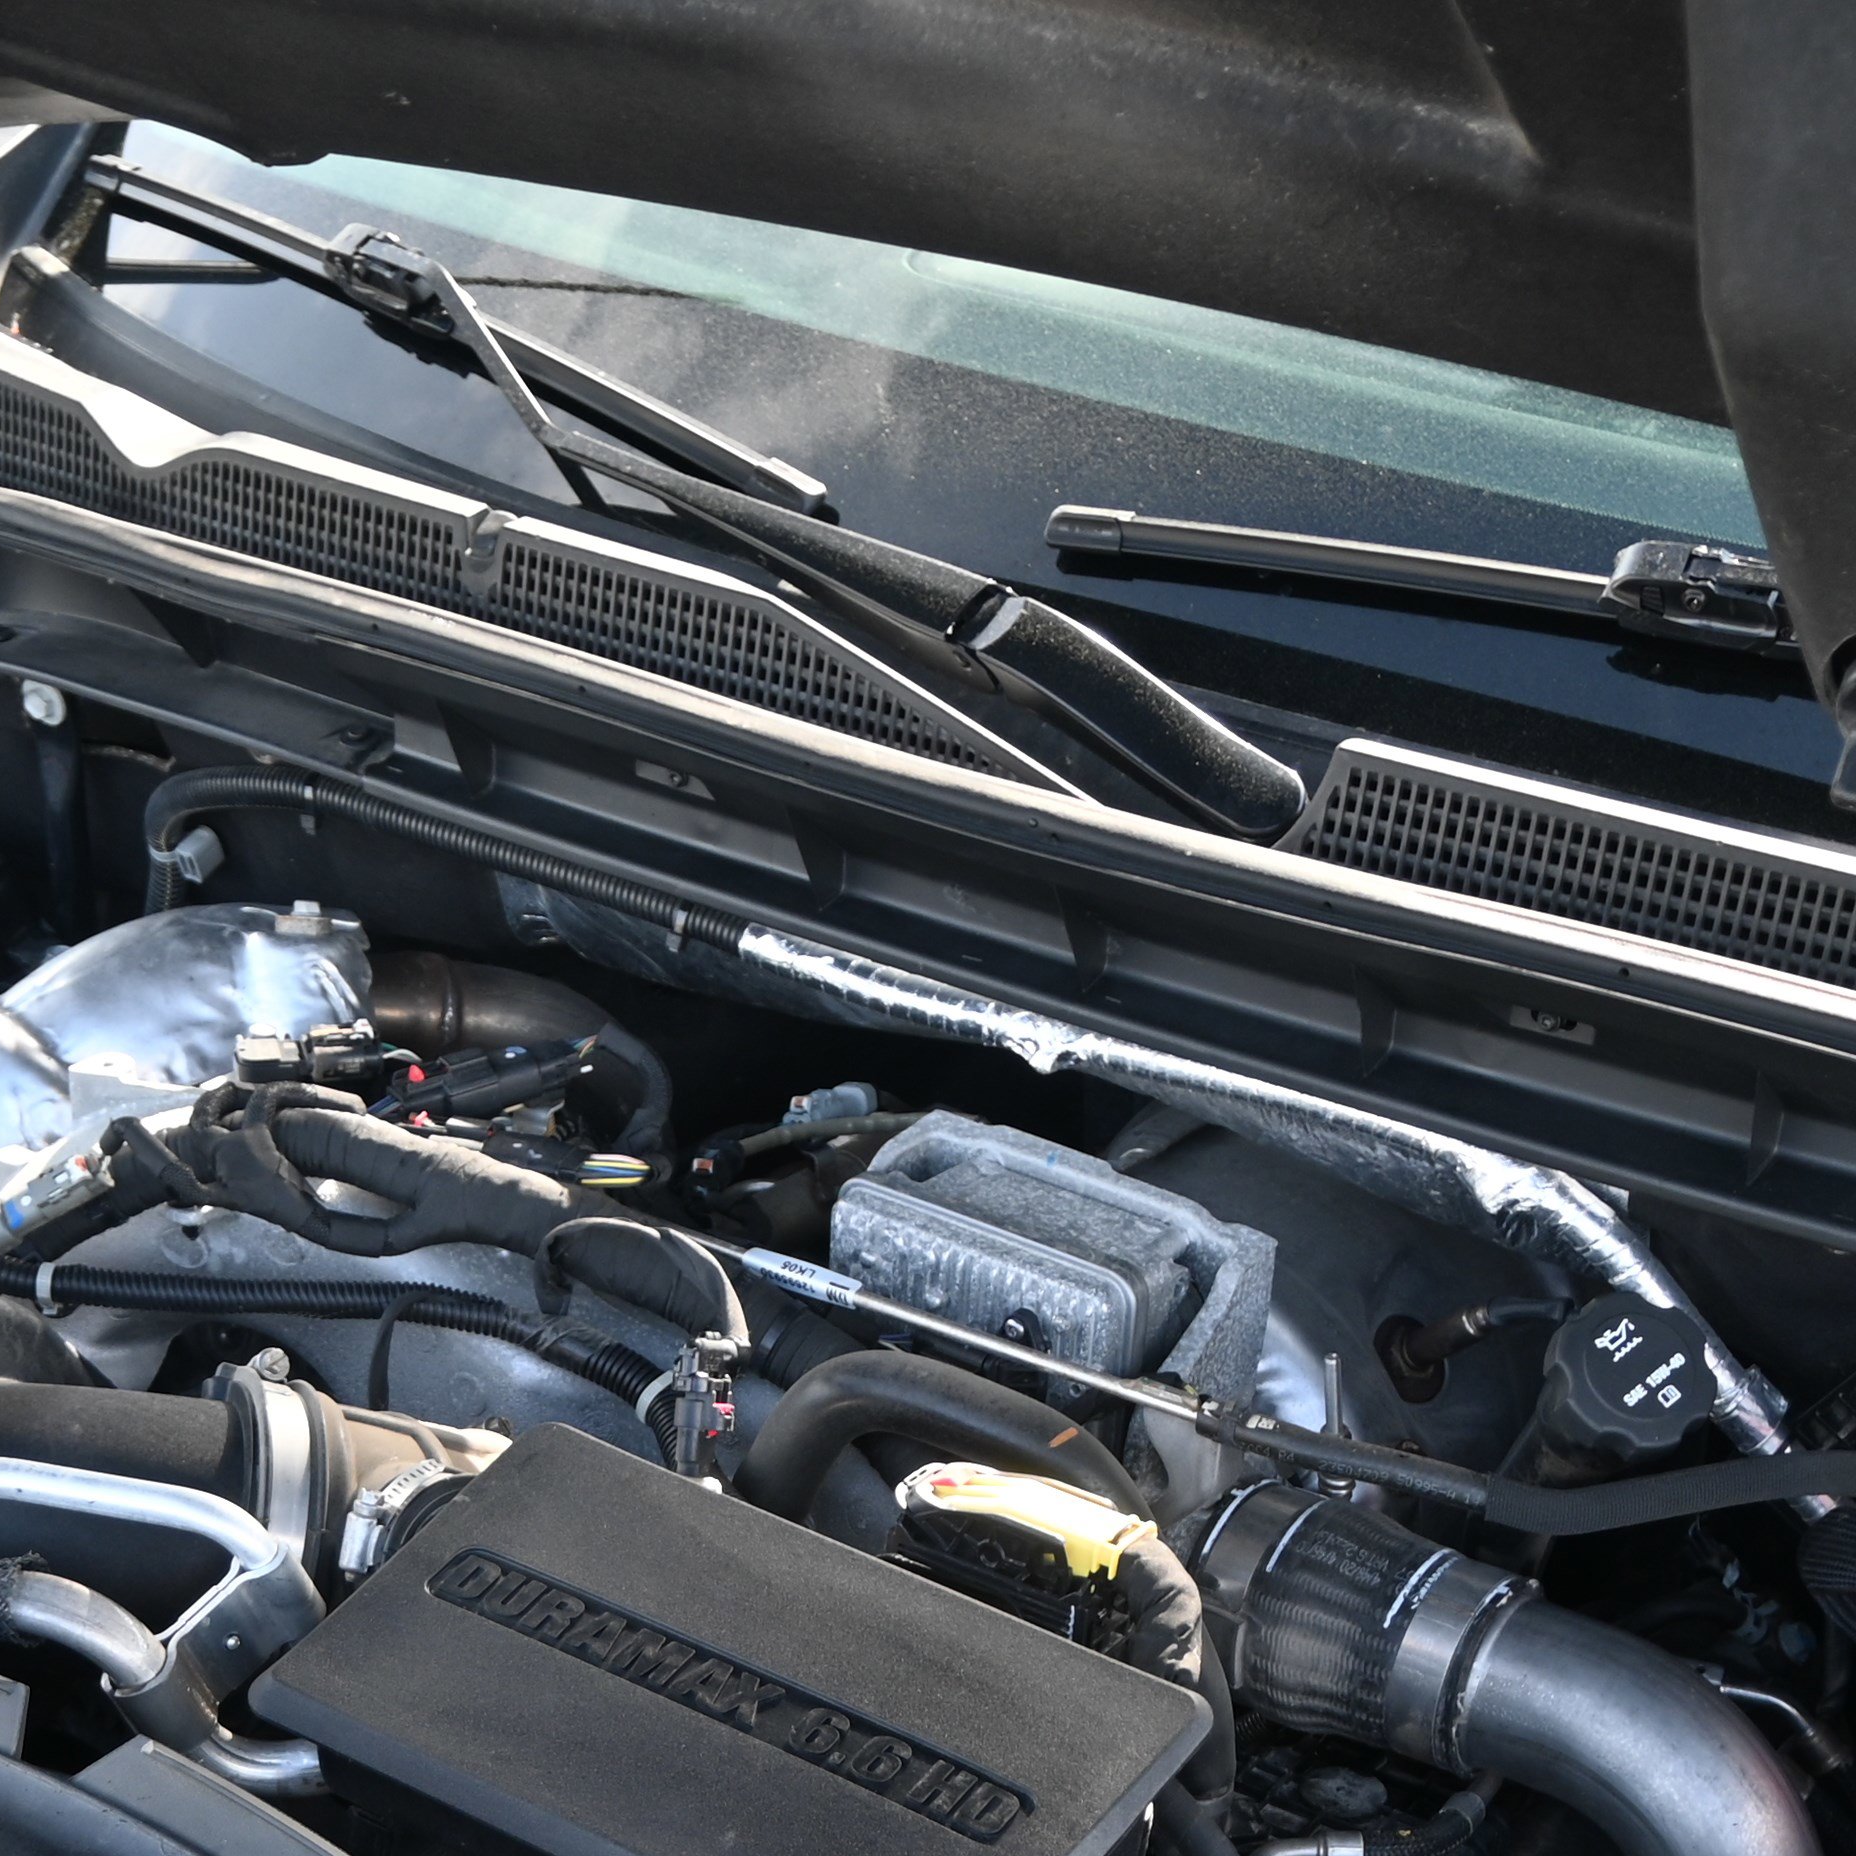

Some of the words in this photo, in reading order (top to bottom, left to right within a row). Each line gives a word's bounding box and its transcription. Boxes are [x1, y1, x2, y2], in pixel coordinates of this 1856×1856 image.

[779, 1259, 816, 1278] LK05
[1623, 1383, 1648, 1407] SAE
[1645, 1352, 1686, 1388] 15W-40
[448, 1556, 786, 1728] DURAMAX
[789, 1706, 913, 1783] 6.6
[906, 1759, 1022, 1838] HD
